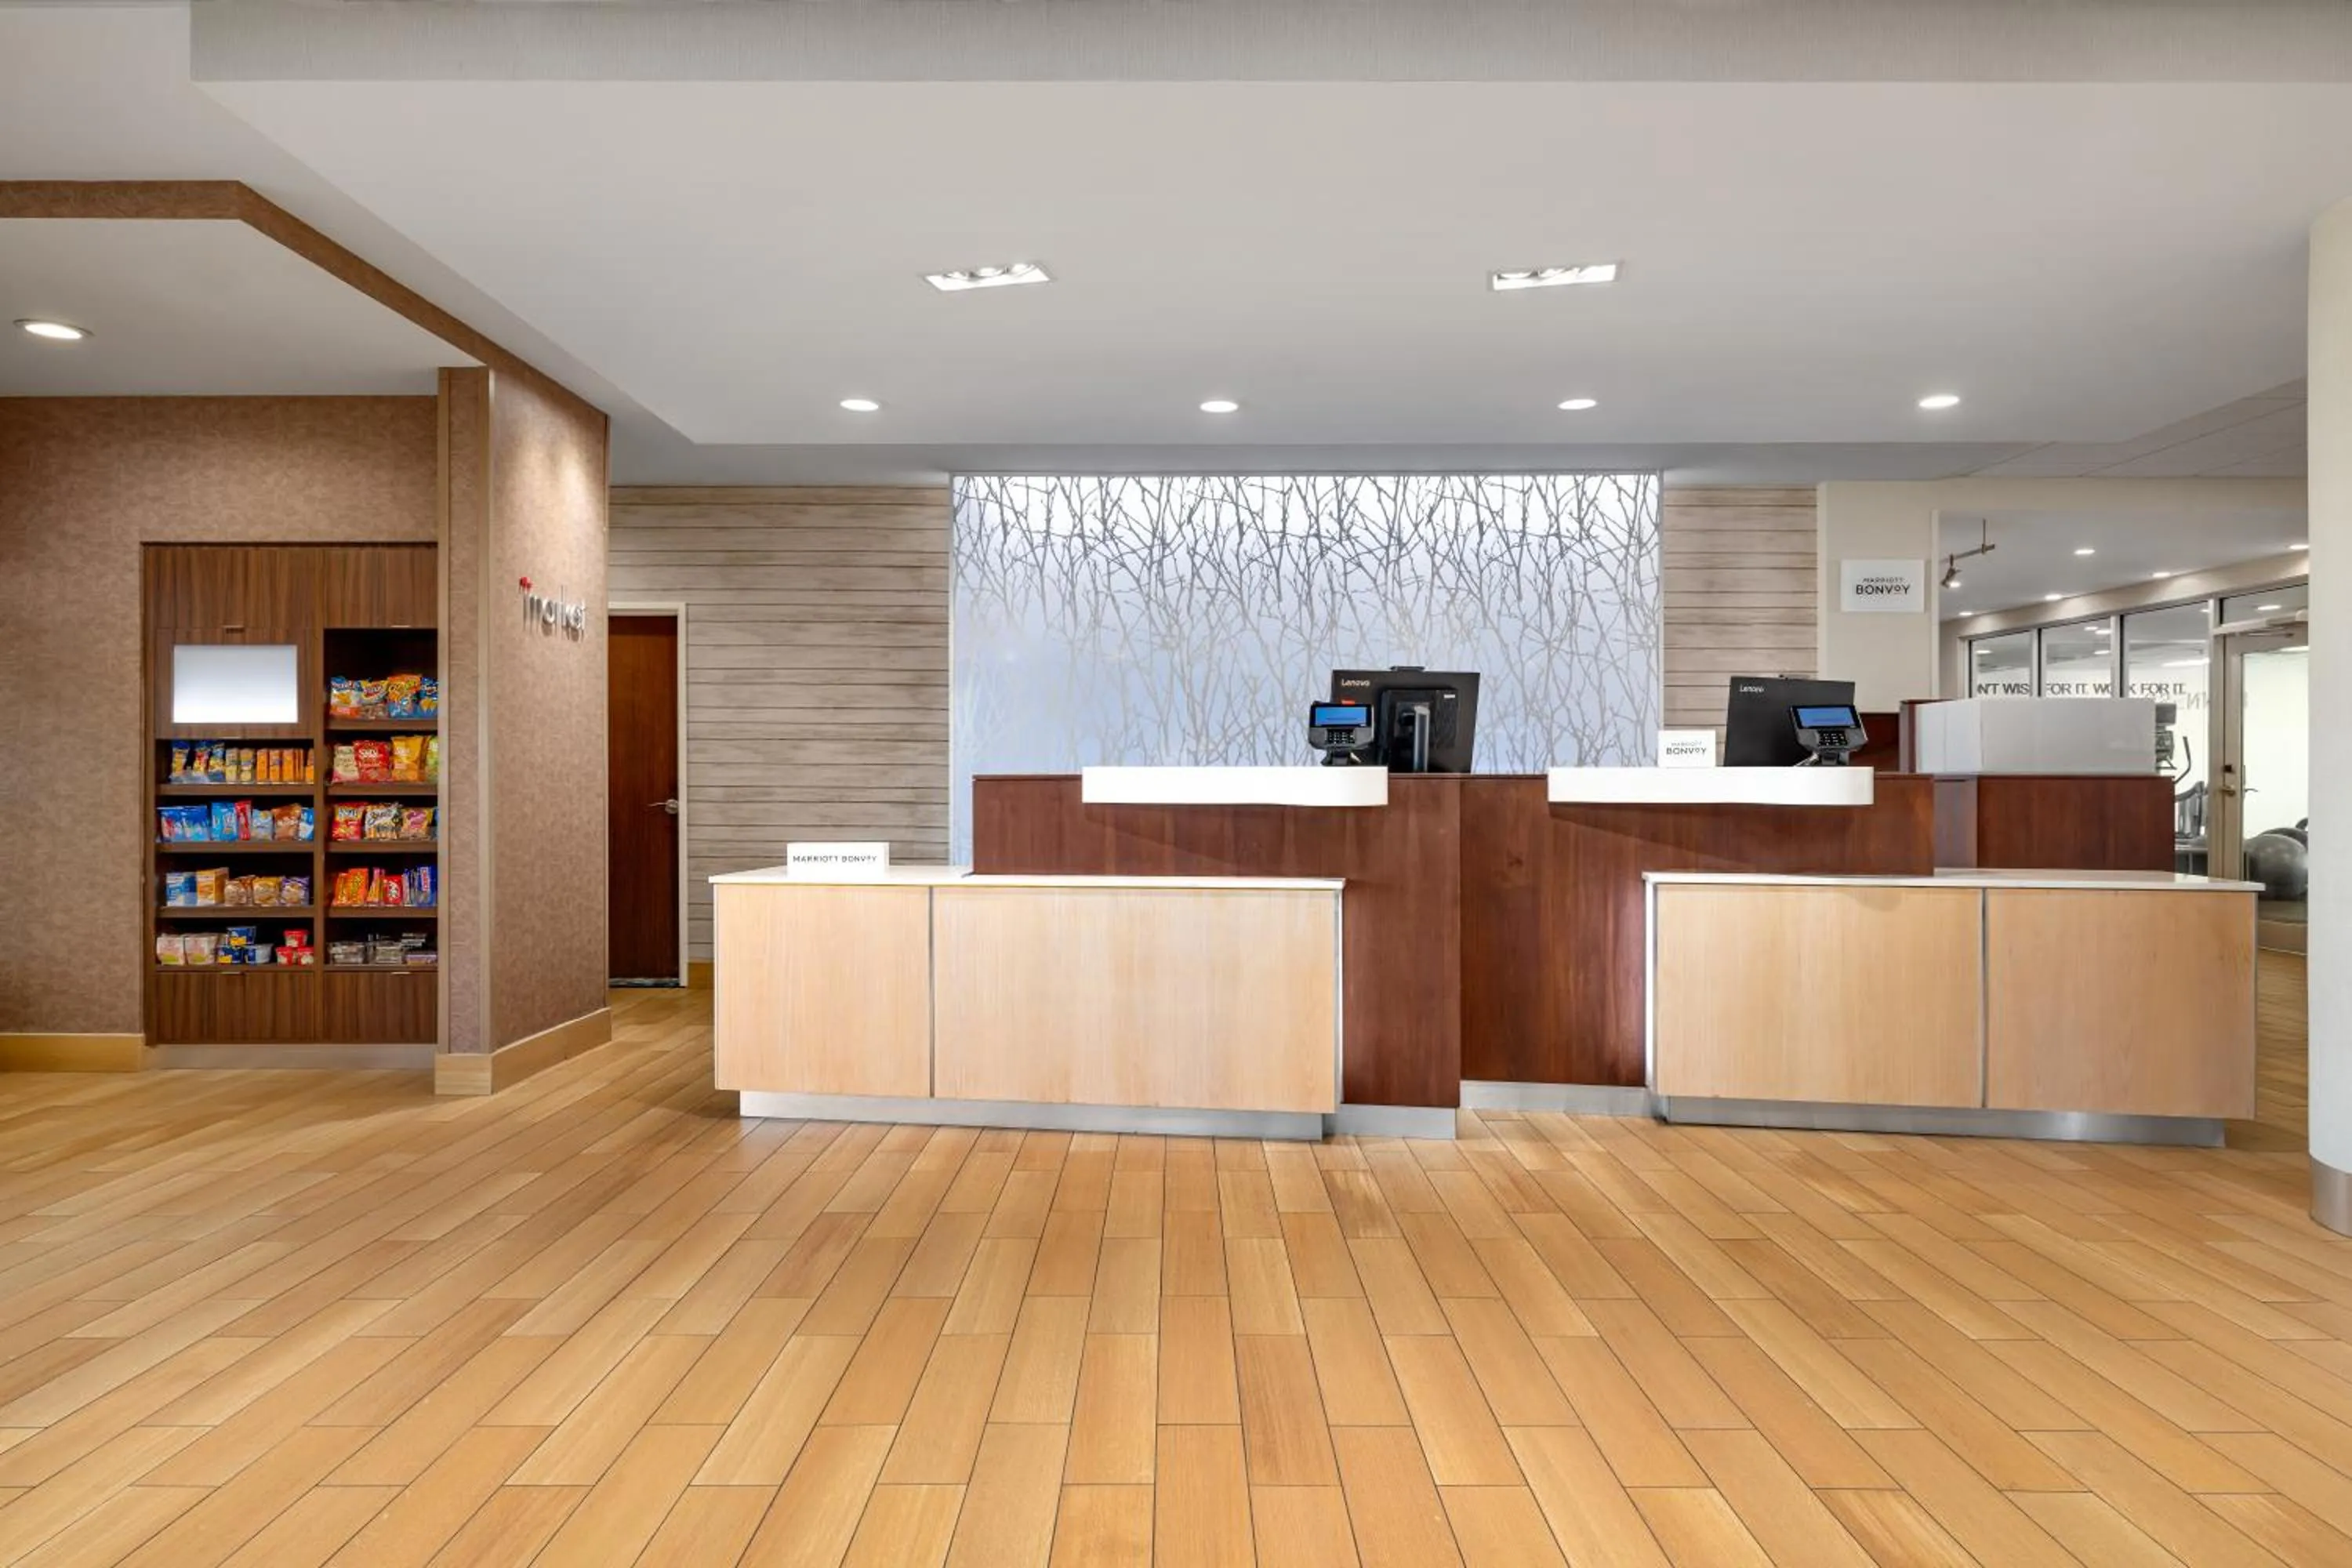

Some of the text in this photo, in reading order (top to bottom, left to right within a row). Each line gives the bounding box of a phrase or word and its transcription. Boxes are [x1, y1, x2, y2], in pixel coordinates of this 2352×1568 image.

[1856, 584, 1910, 596] BONVOY
[1341, 678, 1370, 687] Lenovo
[2002, 683, 2030, 695] WIS
[2141, 683, 2169, 695] FOR
[793, 855, 838, 863] MARRIOTT
